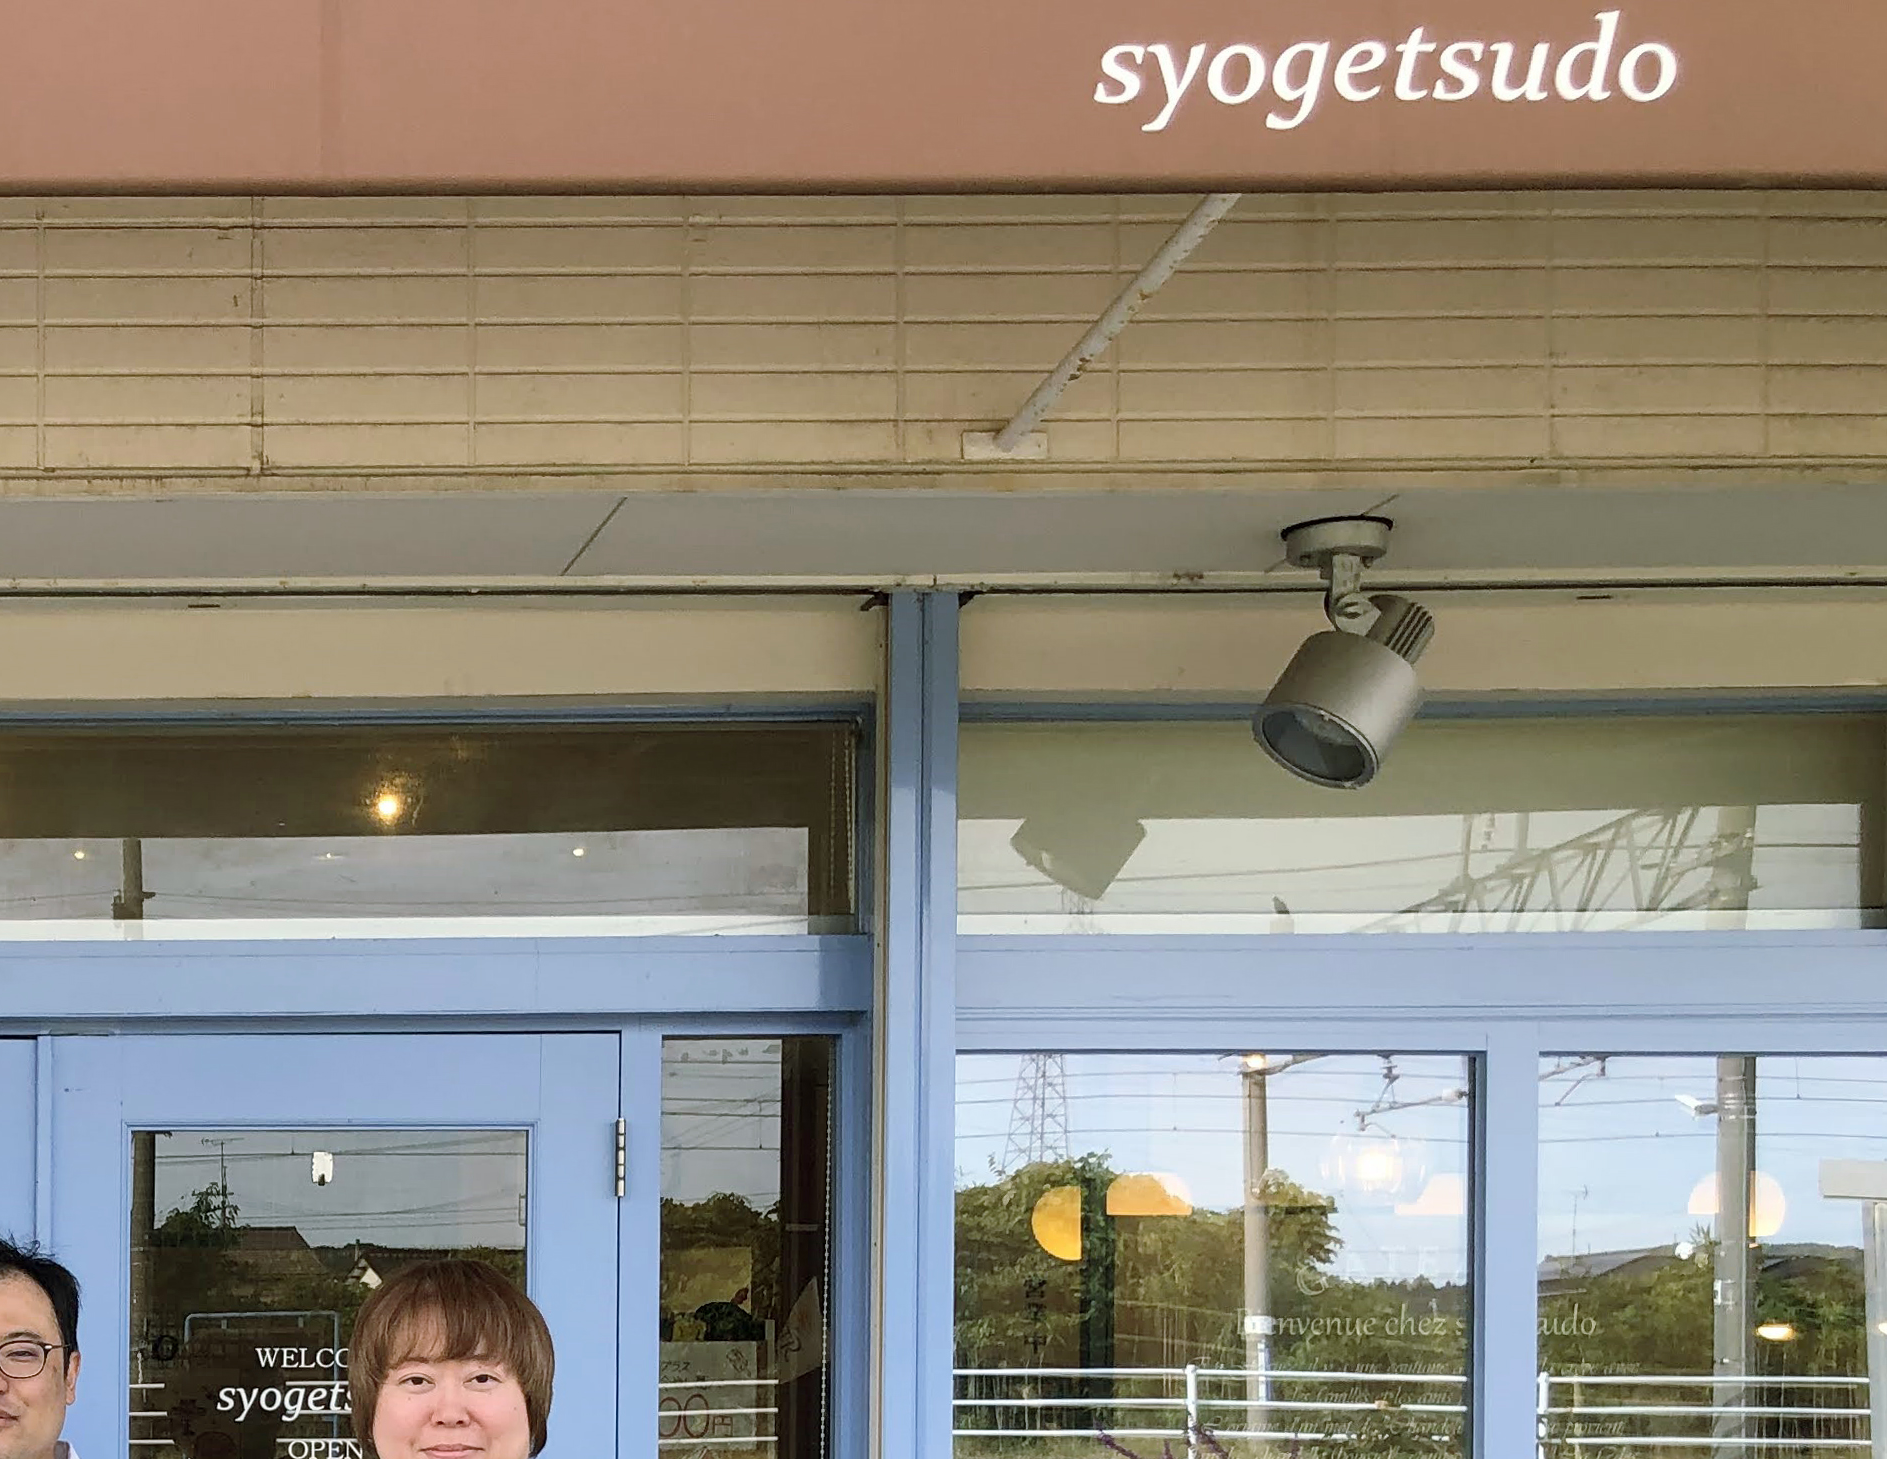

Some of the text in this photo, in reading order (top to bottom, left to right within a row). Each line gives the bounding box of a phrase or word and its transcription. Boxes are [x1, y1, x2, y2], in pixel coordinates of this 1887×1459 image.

[1093, 9, 1678, 132] syogetsudo
[1384, 1303, 1447, 1336] chez
[254, 1347, 350, 1368] WELCO
[216, 1382, 353, 1422] syoget
[287, 1439, 363, 1459] OPEN
